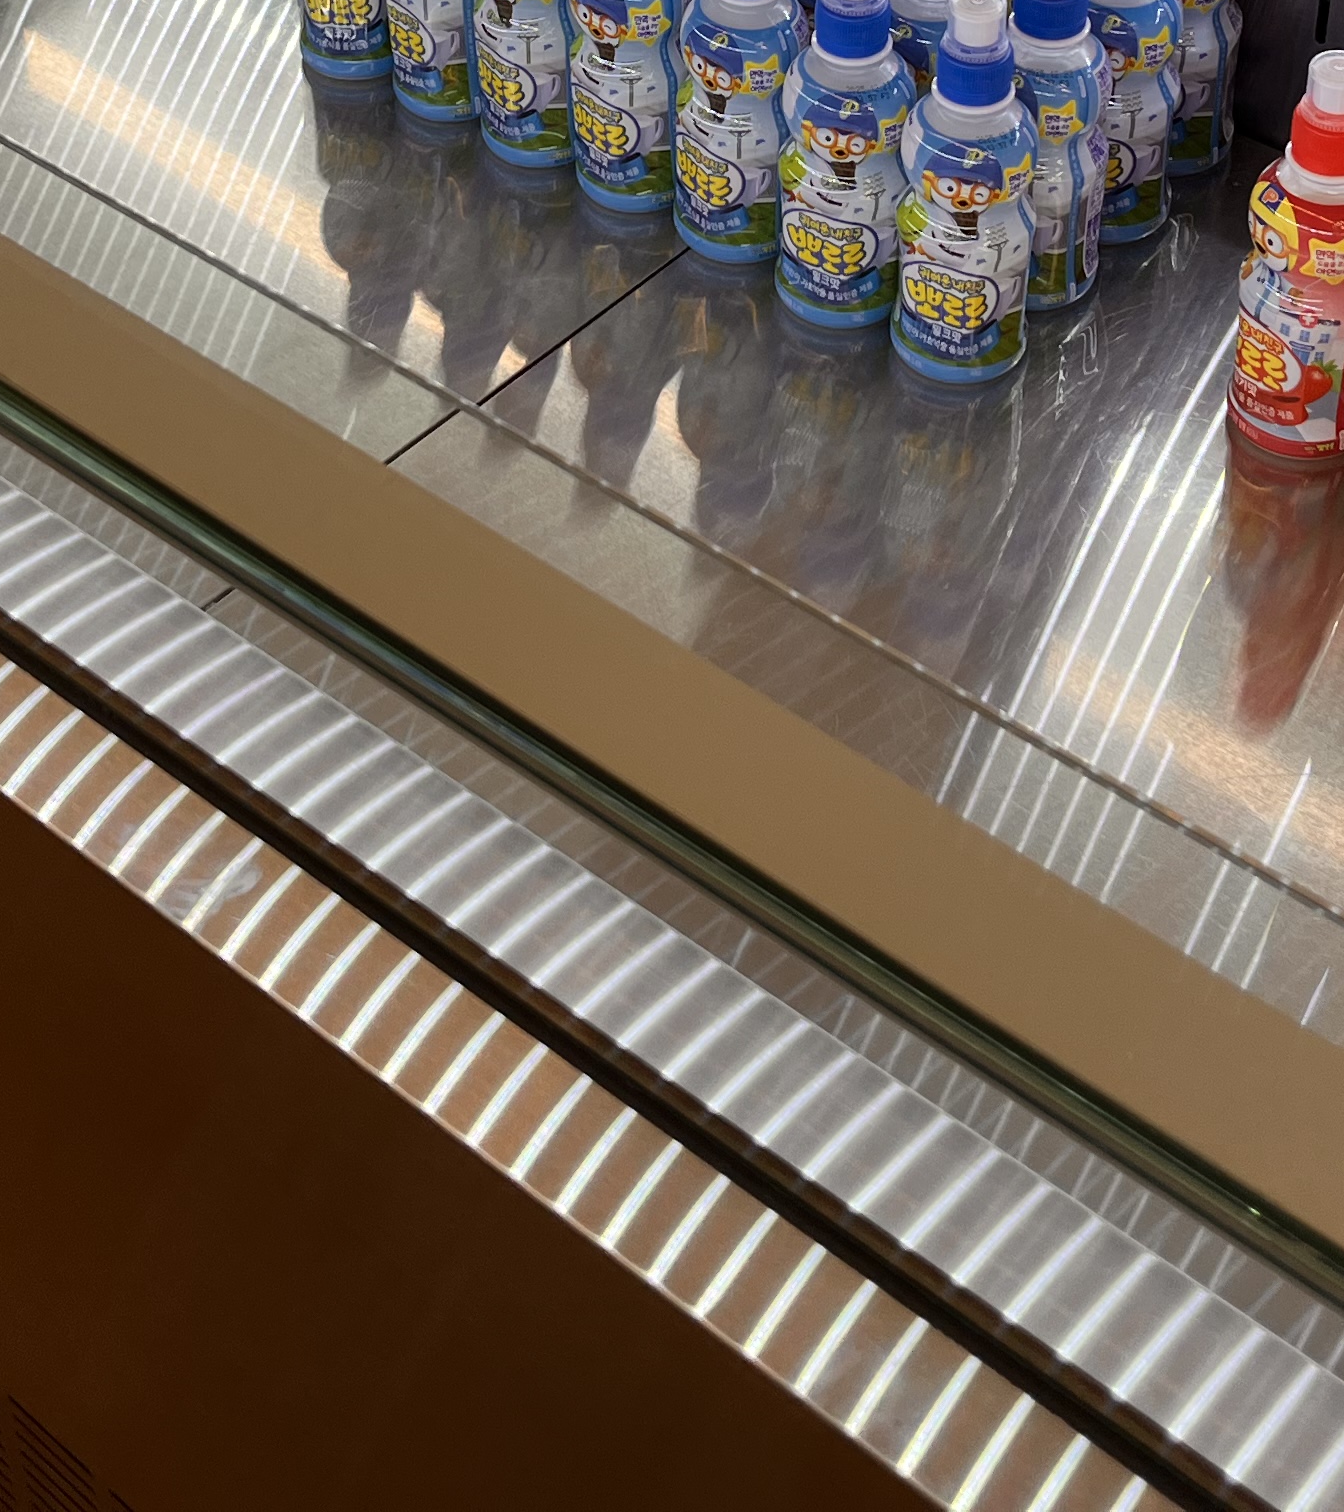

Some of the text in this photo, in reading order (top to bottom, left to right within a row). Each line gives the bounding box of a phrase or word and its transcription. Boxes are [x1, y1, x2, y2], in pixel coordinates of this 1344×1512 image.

[478, 57, 525, 112] 뽀로로
[574, 101, 628, 156] 뽀로로
[676, 147, 732, 207] 뽀로로
[798, 212, 864, 241] 귀여운 내친구
[786, 222, 866, 276] 뽀로로
[812, 269, 841, 290] 밀크맛
[918, 264, 951, 289] 귀여운
[905, 276, 988, 330] 뽀로로
[932, 323, 962, 344] 밀크맛
[1248, 328, 1285, 356] 내친구
[1277, 409, 1295, 421] 제품
